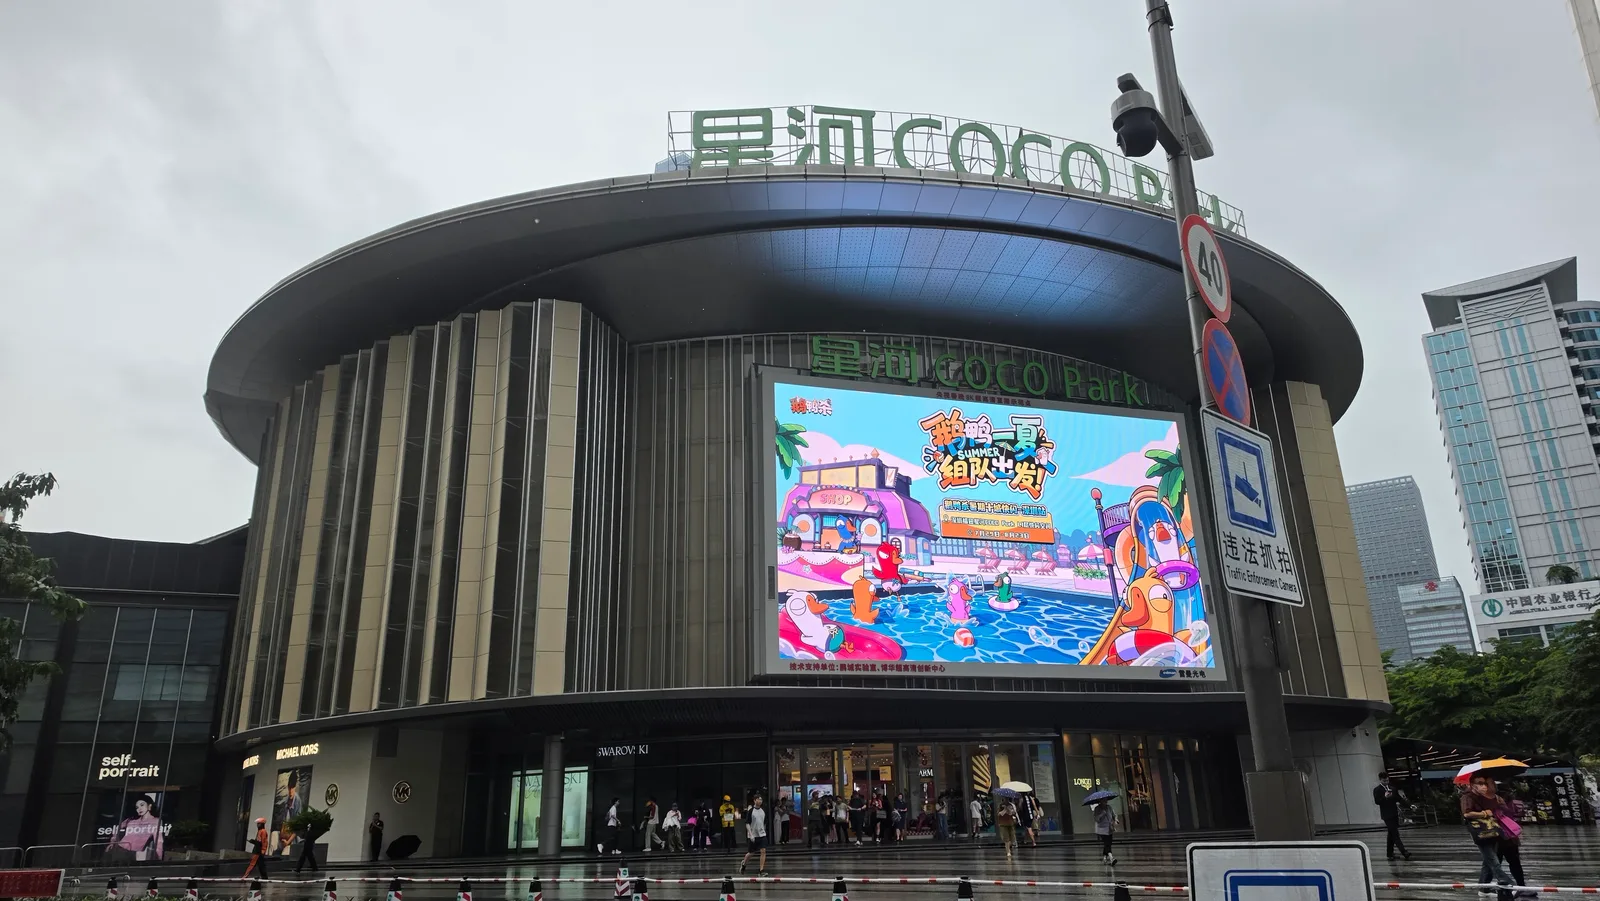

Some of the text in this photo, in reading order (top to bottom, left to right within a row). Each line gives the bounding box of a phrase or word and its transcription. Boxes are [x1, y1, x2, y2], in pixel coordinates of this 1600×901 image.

[693, 107, 1240, 233] 星河 COCO Pk
[1198, 240, 1224, 298] 40
[812, 336, 1144, 406] 星河 COCO Park
[789, 396, 833, 416] 鹅鸭杀
[919, 408, 1042, 462] 鹅鸭一夏
[957, 447, 1001, 461] SUMMER
[820, 493, 853, 506] SHOP
[1222, 530, 1294, 576] 违法抓拍
[1226, 564, 1298, 593] Traffic Enforcement Camera
[1505, 588, 1591, 609] 中国农业银行
[1509, 606, 1550, 615] AGRICULTURAL
[1178, 669, 1206, 679] 雷曼光电
[101, 754, 136, 767] self-
[276, 742, 319, 760] MICHAEL KORS
[516, 772, 582, 787] SWASKI
[1556, 786, 1572, 818] 海森堡
